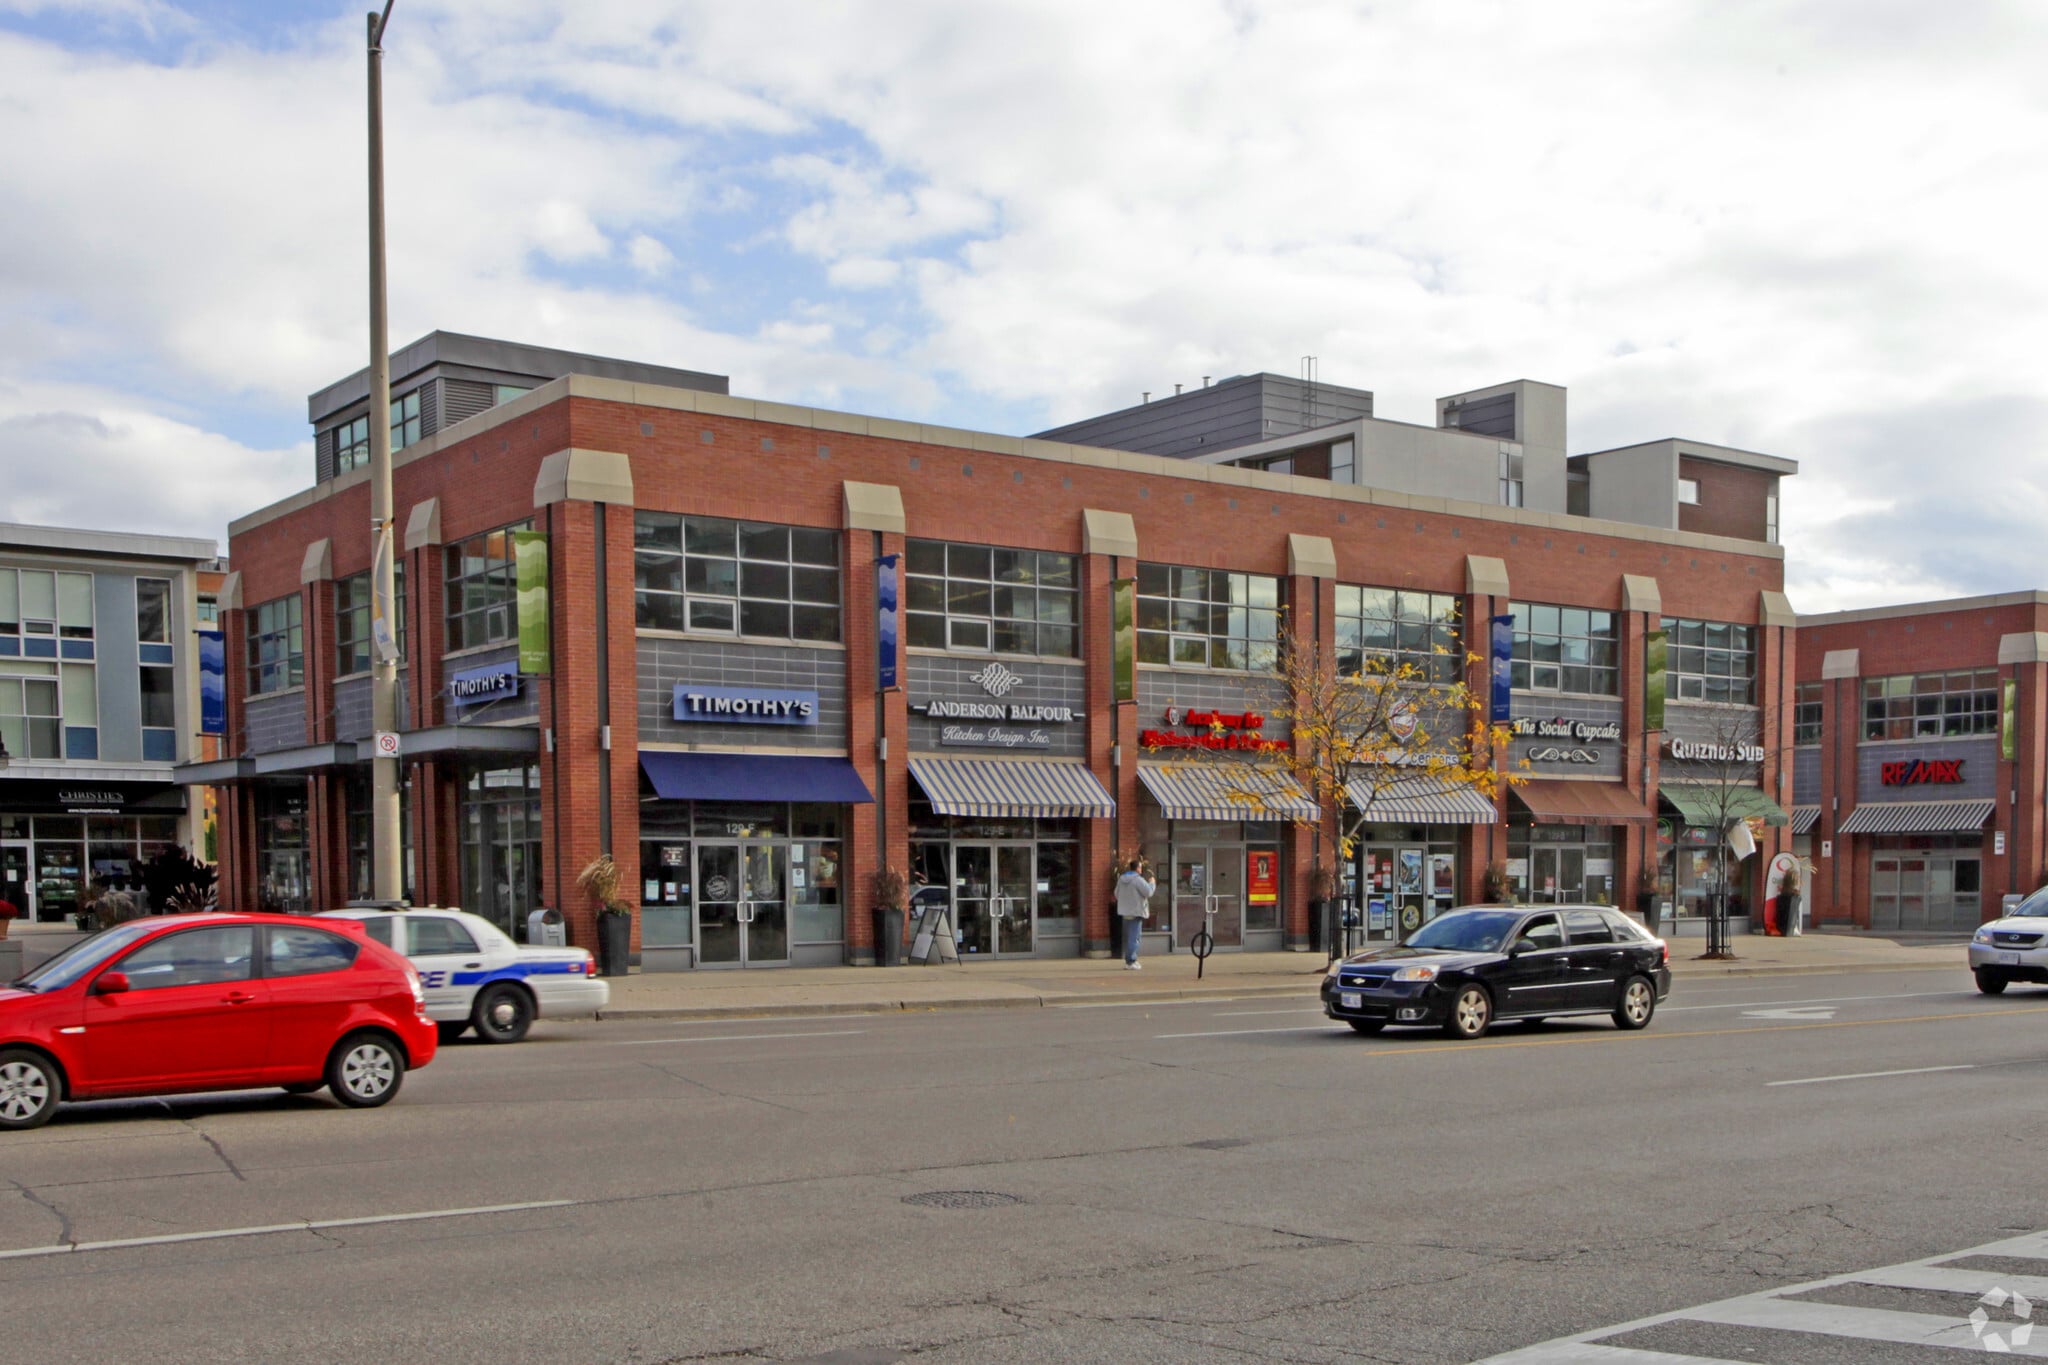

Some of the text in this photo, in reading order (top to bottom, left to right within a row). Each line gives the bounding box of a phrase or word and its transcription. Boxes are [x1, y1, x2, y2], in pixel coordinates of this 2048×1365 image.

[450, 673, 506, 696] TIMOTHY'S
[688, 693, 812, 716] TIMOTHY'S
[928, 701, 1073, 721] ANDERSON BALFOUR
[943, 726, 1050, 746] Kitchen Design Inc.
[1513, 718, 1620, 742] The Social Cupcake
[1881, 759, 1962, 787] RE/MAX
